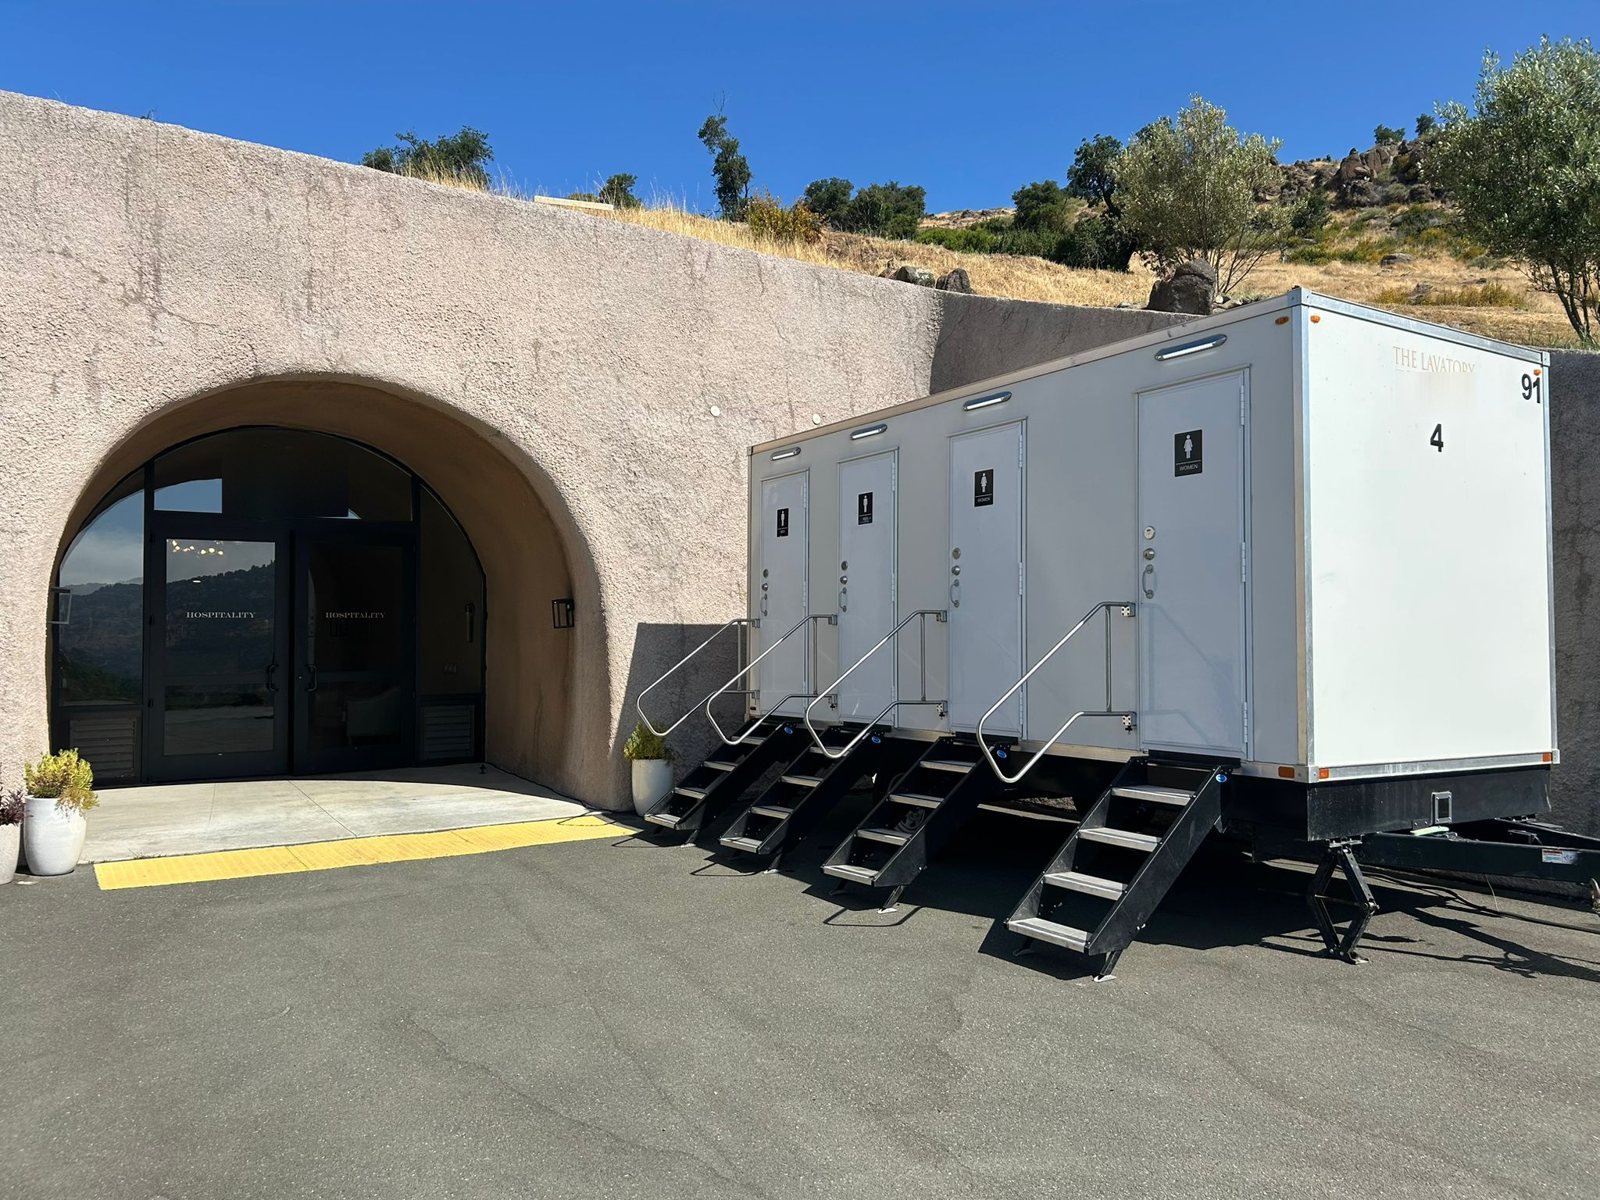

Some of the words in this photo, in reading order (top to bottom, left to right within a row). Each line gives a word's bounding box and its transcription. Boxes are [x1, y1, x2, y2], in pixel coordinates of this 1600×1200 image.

[1393, 346, 1417, 369] THE
[1521, 373, 1541, 404] 91
[1430, 423, 1444, 453] 4
[1179, 463, 1199, 471] WOMEN
[186, 611, 256, 619] HOSPITALITY
[326, 611, 386, 619] HOSPITALITY
